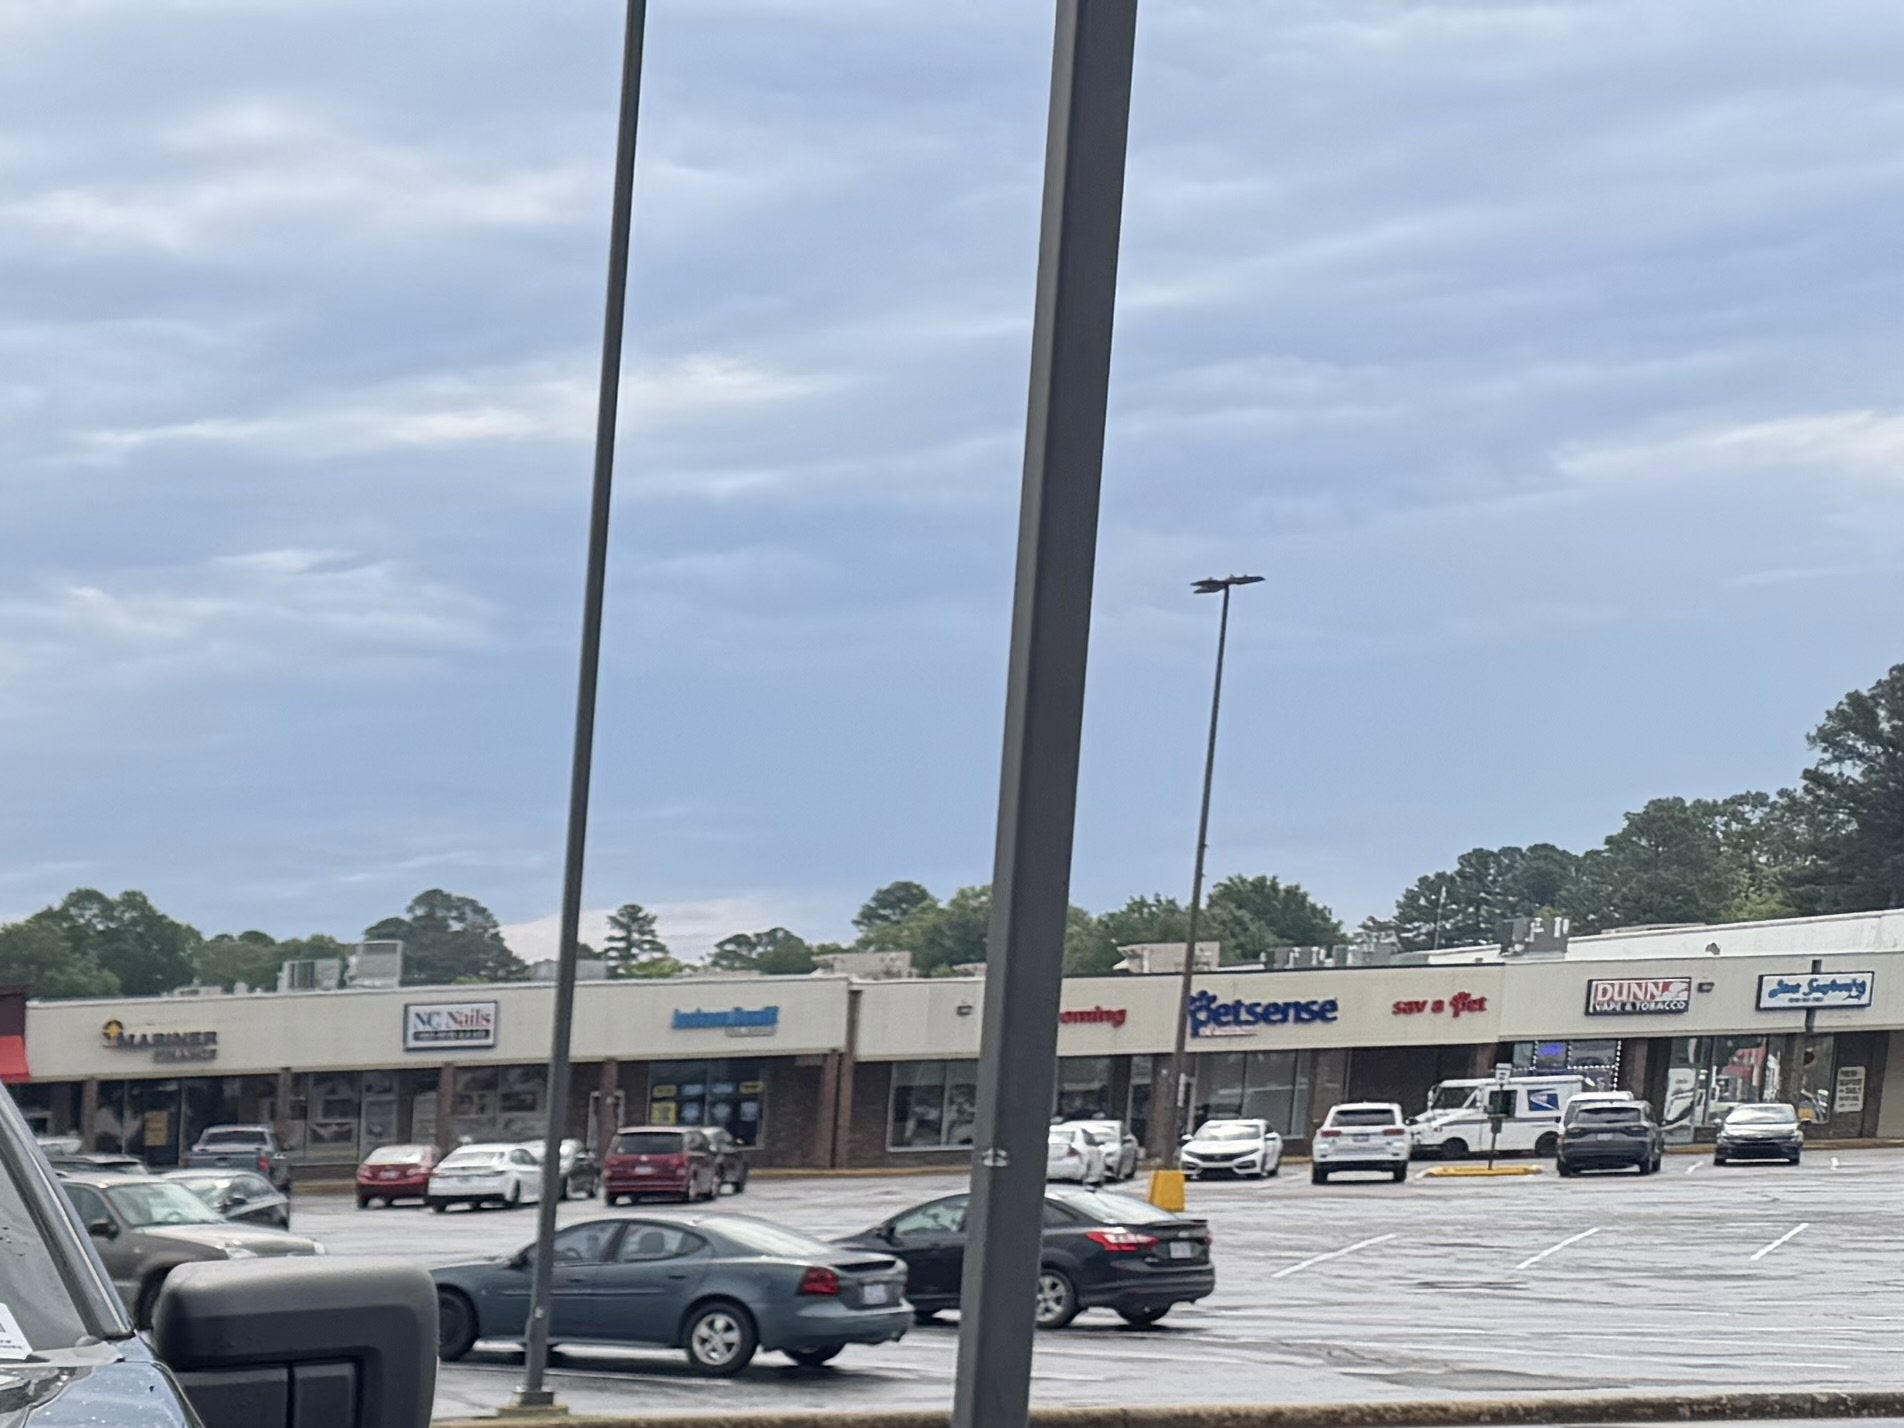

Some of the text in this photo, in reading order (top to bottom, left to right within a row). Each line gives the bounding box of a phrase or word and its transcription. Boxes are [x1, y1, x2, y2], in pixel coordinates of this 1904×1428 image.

[1596, 982, 1663, 1001] DUNN
[1594, 1001, 1621, 1011] VAPE
[1636, 1000, 1686, 1011] TOBACCO
